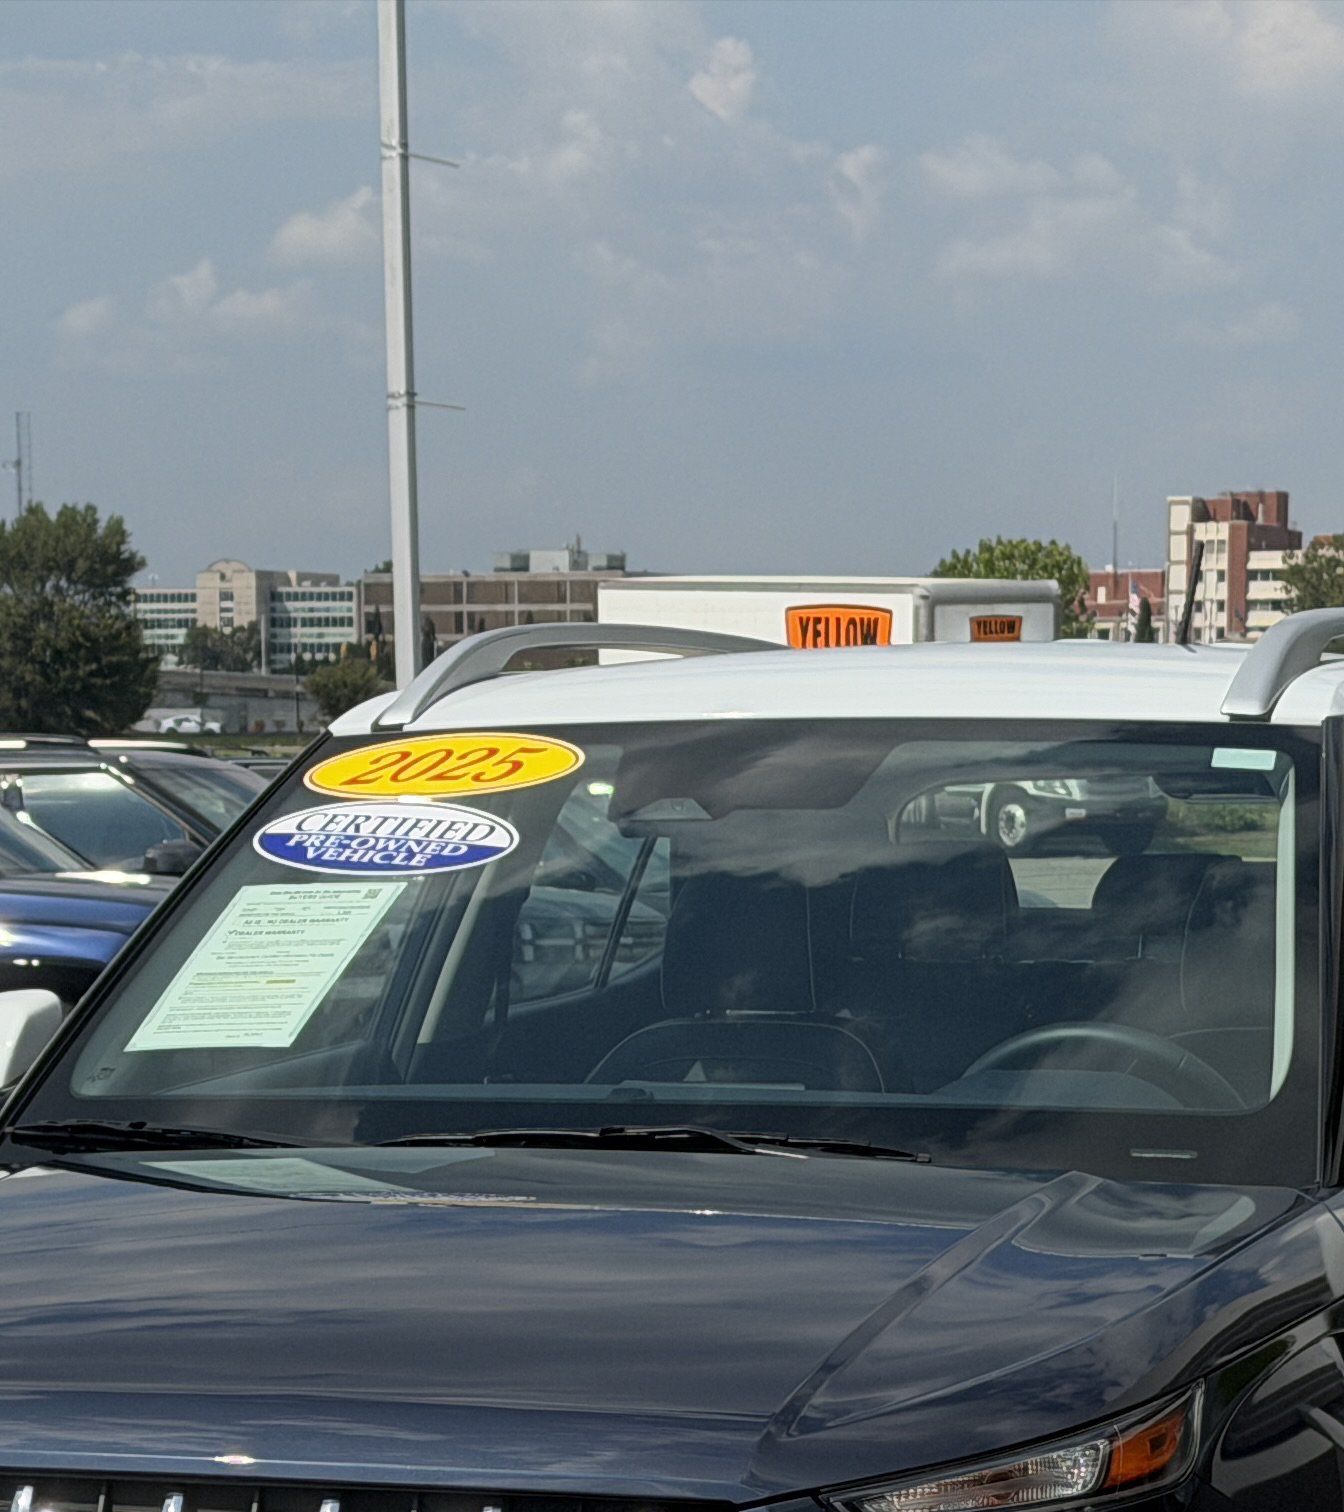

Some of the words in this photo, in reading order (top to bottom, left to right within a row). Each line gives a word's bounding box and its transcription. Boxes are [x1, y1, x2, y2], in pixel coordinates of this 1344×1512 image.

[798, 616, 879, 648] YELLOW
[976, 620, 1015, 635] YELLOW
[340, 747, 548, 785] 2025
[296, 813, 496, 842] CERTIFIED
[287, 834, 468, 856] PRE-OWNED
[306, 847, 432, 866] VEHICLE
